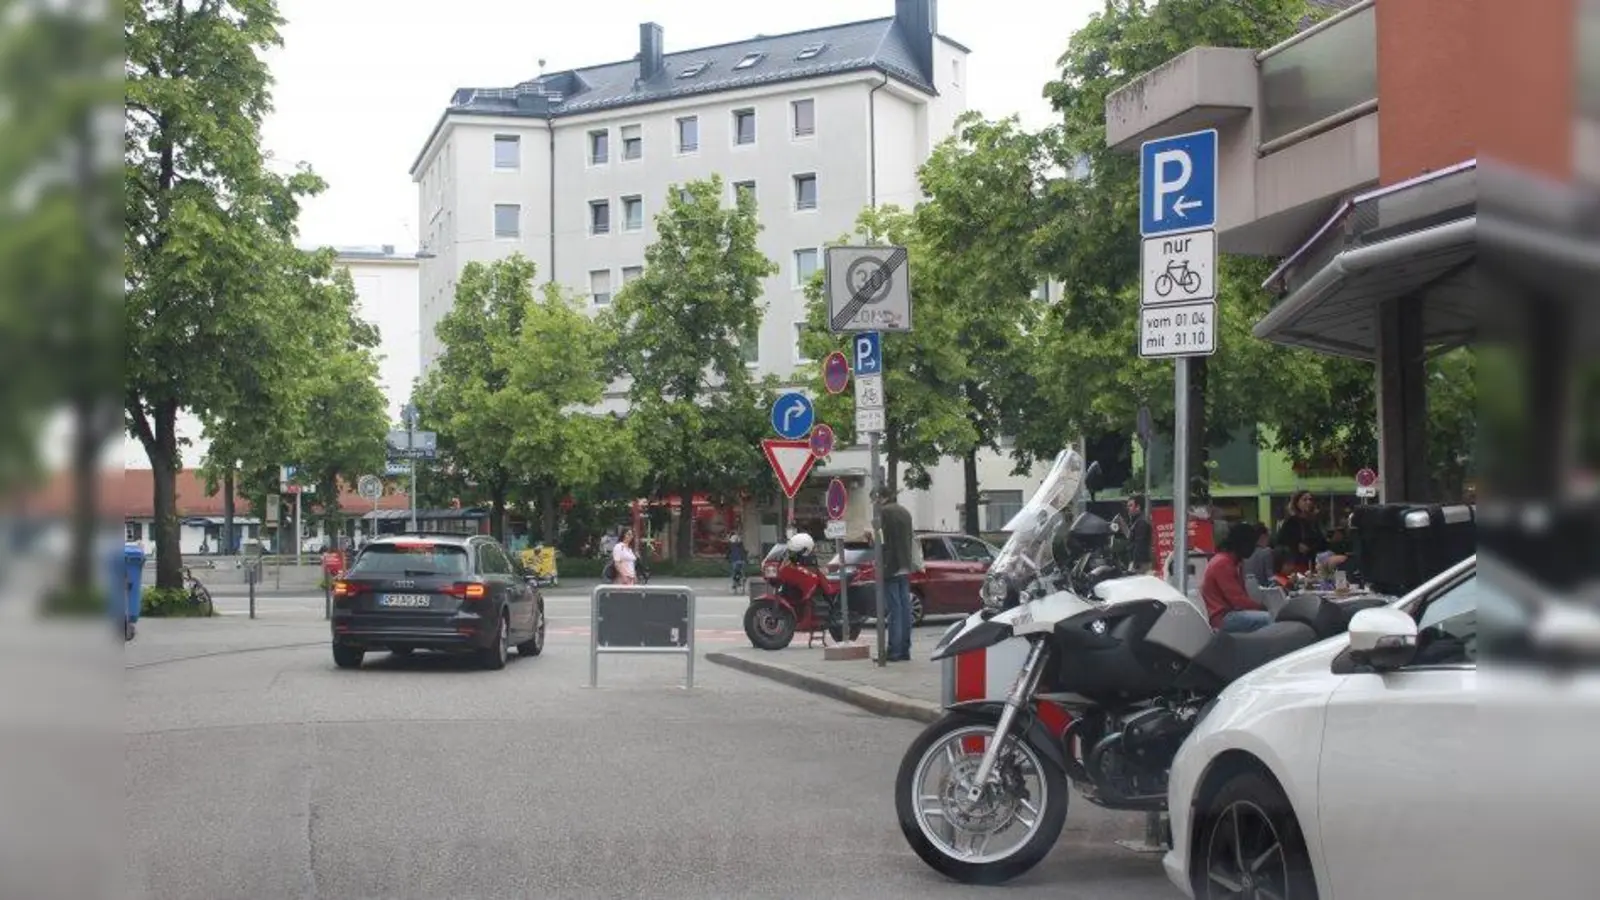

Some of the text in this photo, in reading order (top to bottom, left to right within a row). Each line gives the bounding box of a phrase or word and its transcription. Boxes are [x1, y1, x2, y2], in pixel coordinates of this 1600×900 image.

[1153, 149, 1192, 221] P
[1163, 238, 1191, 255] nur
[1147, 316, 1171, 328] vom
[1146, 335, 1165, 348] mit
[857, 338, 872, 370] P
